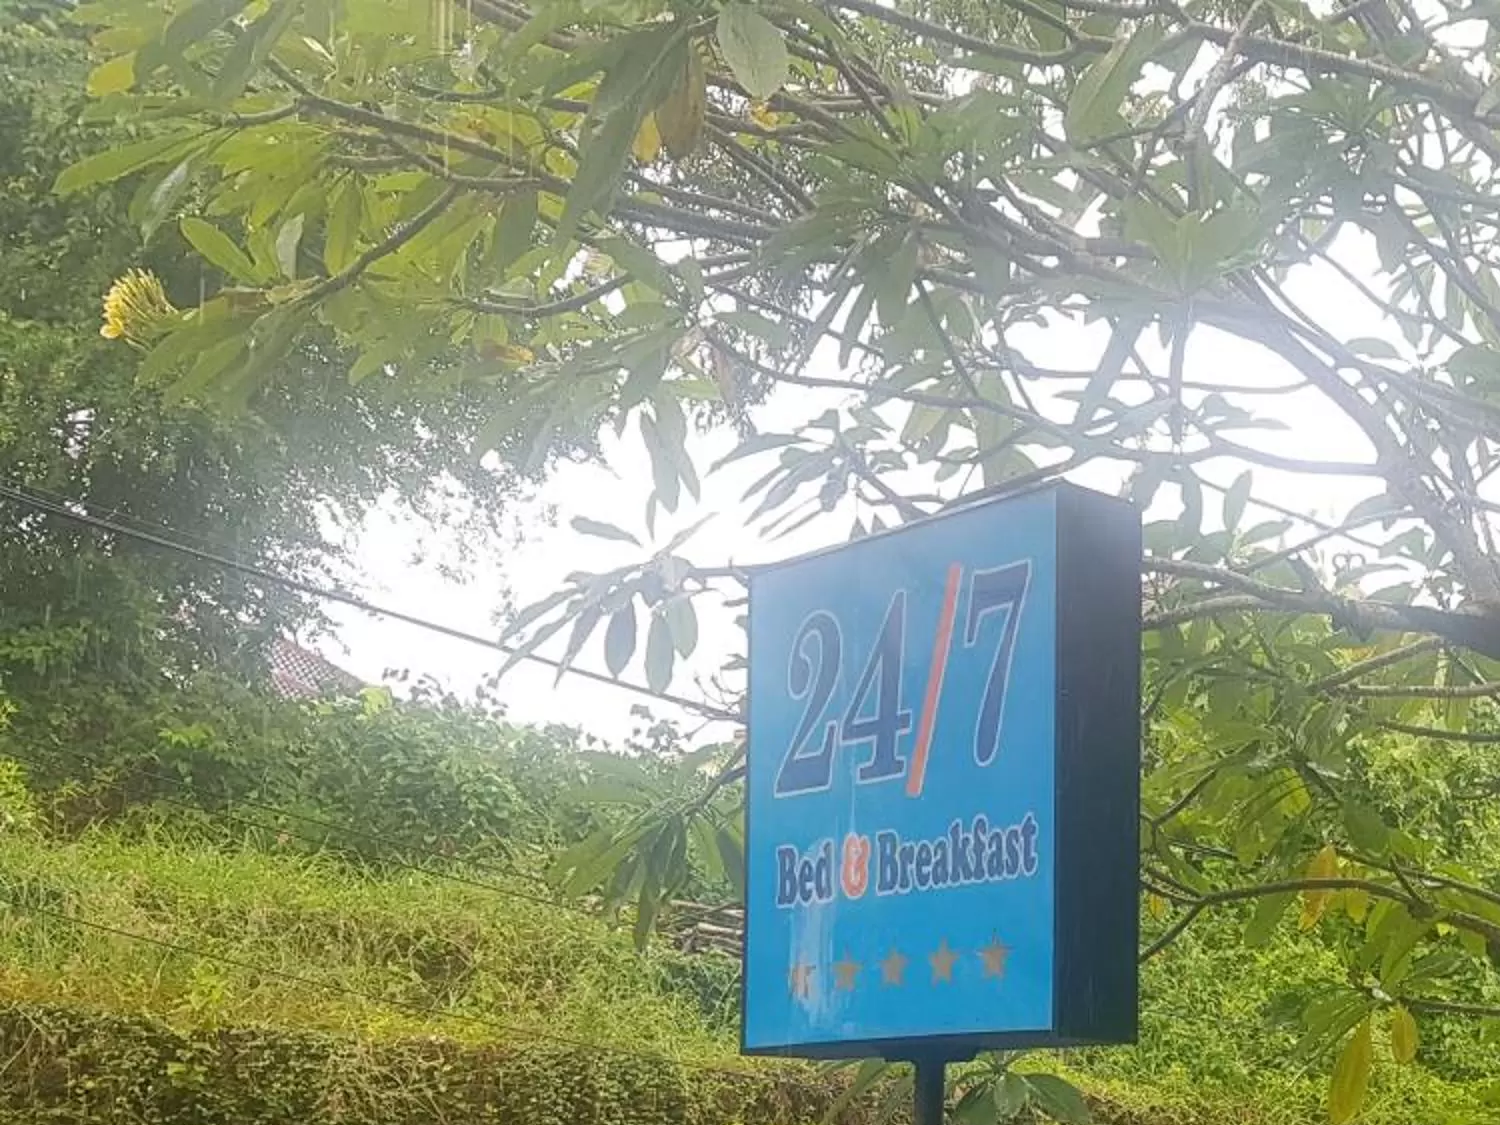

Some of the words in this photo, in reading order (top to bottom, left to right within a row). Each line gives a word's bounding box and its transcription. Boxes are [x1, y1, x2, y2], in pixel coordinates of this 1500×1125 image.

[774, 559, 1032, 798] 24/7
[776, 838, 835, 909] Bed
[841, 832, 870, 899] &
[875, 811, 1039, 896] Breakfast
